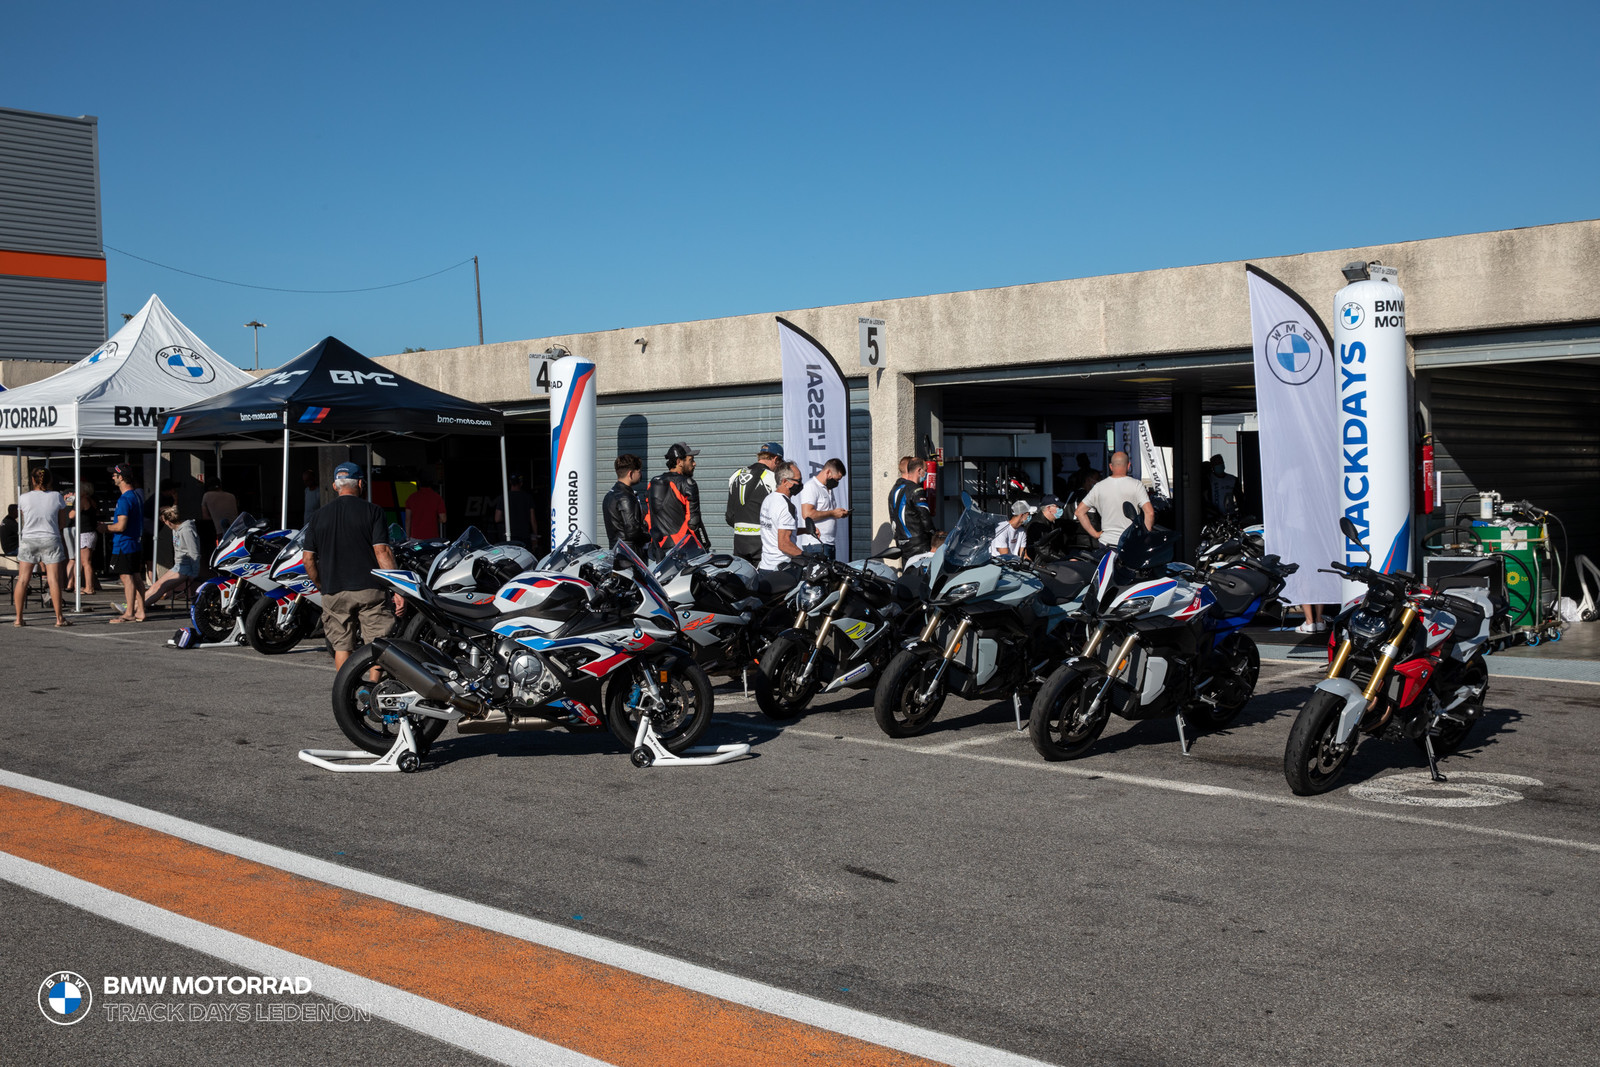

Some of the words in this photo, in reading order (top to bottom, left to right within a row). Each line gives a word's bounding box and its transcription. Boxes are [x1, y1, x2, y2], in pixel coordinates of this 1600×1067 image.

[1375, 315, 1405, 328] MOT
[867, 327, 879, 365] 5
[329, 370, 399, 387] BMC
[536, 361, 551, 393] 4
[114, 405, 176, 426] BM
[240, 412, 278, 422] bmc-moto.com
[437, 415, 492, 426] bmc-moto.com
[1340, 340, 1370, 575] TRACKDAYS
[568, 470, 578, 537] OTORRAD
